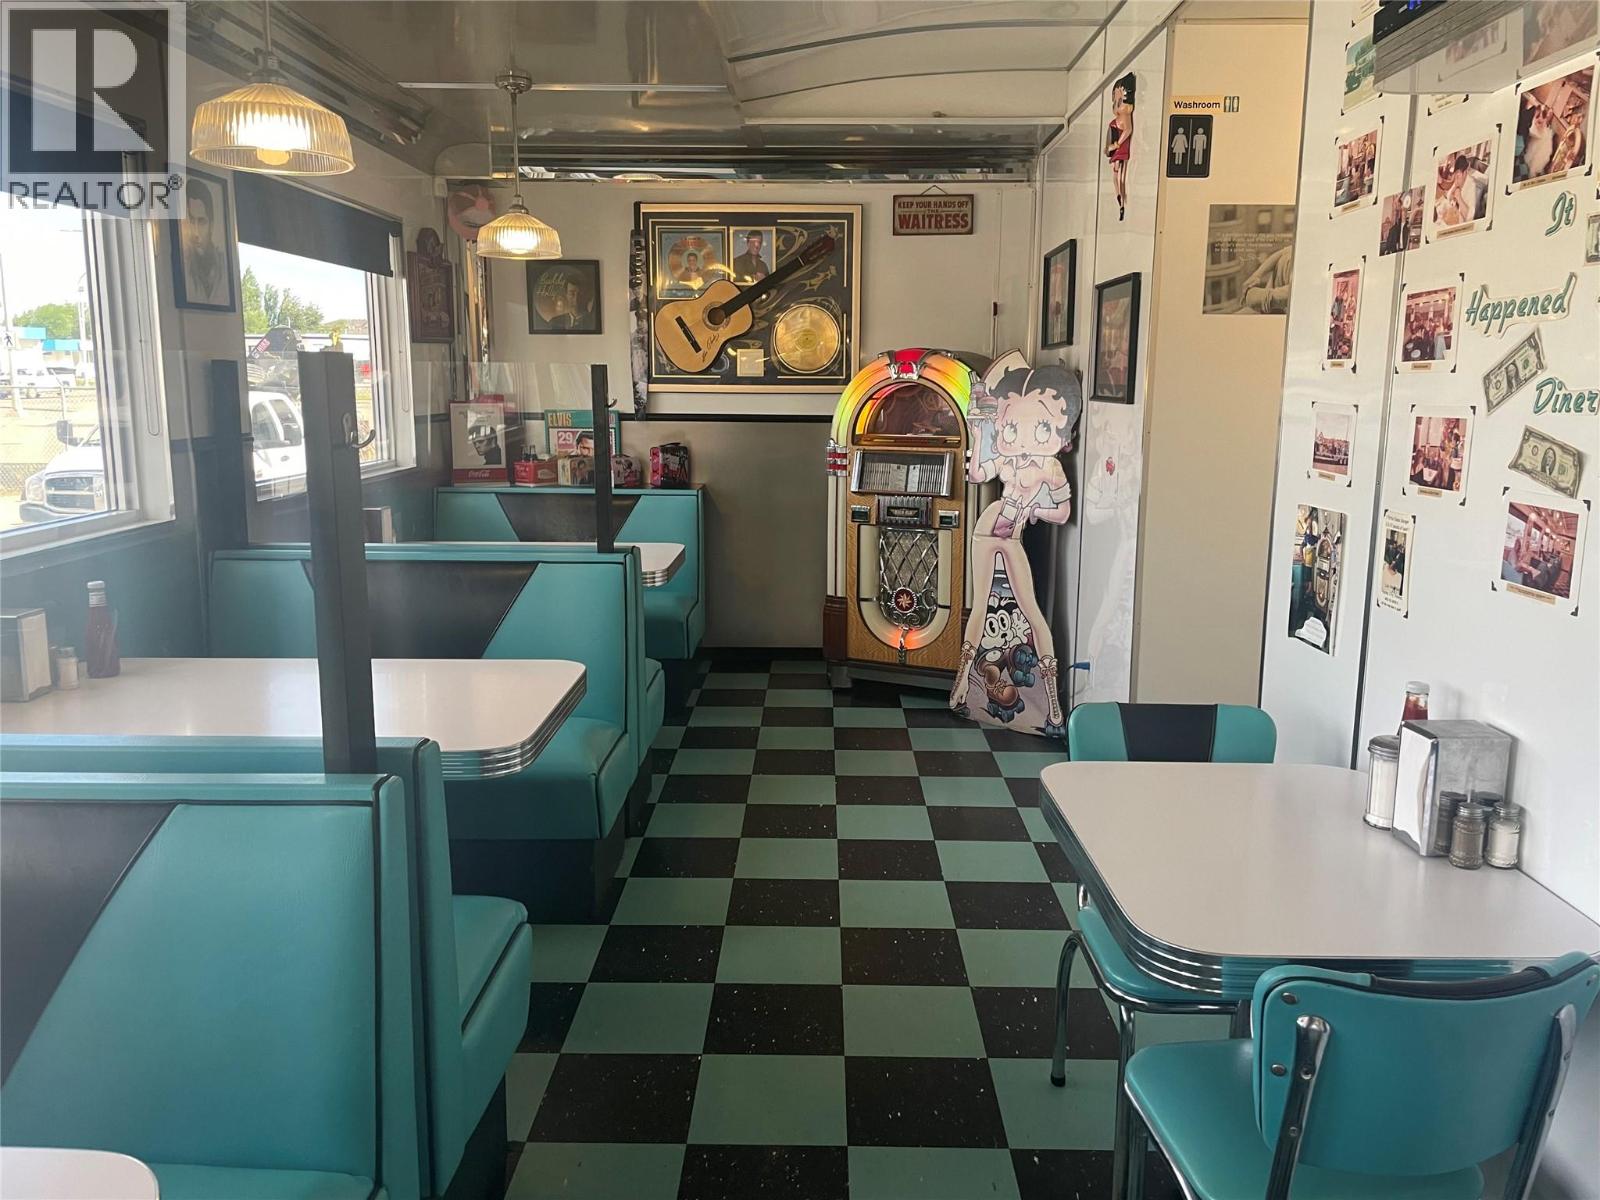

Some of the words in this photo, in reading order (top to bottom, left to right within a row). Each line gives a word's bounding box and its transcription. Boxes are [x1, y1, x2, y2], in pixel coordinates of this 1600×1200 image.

[1173, 100, 1221, 109] Washroom
[897, 201, 914, 209] KEEP
[915, 201, 932, 209] YOUR
[933, 201, 957, 209] HANDS
[957, 200, 969, 208] OFF
[897, 213, 969, 229] WAITRESS
[1544, 191, 1575, 236] It
[1465, 272, 1577, 334] Happened
[1534, 377, 1599, 414] Diner
[547, 412, 572, 427] ELVIS
[557, 431, 573, 445] 29
